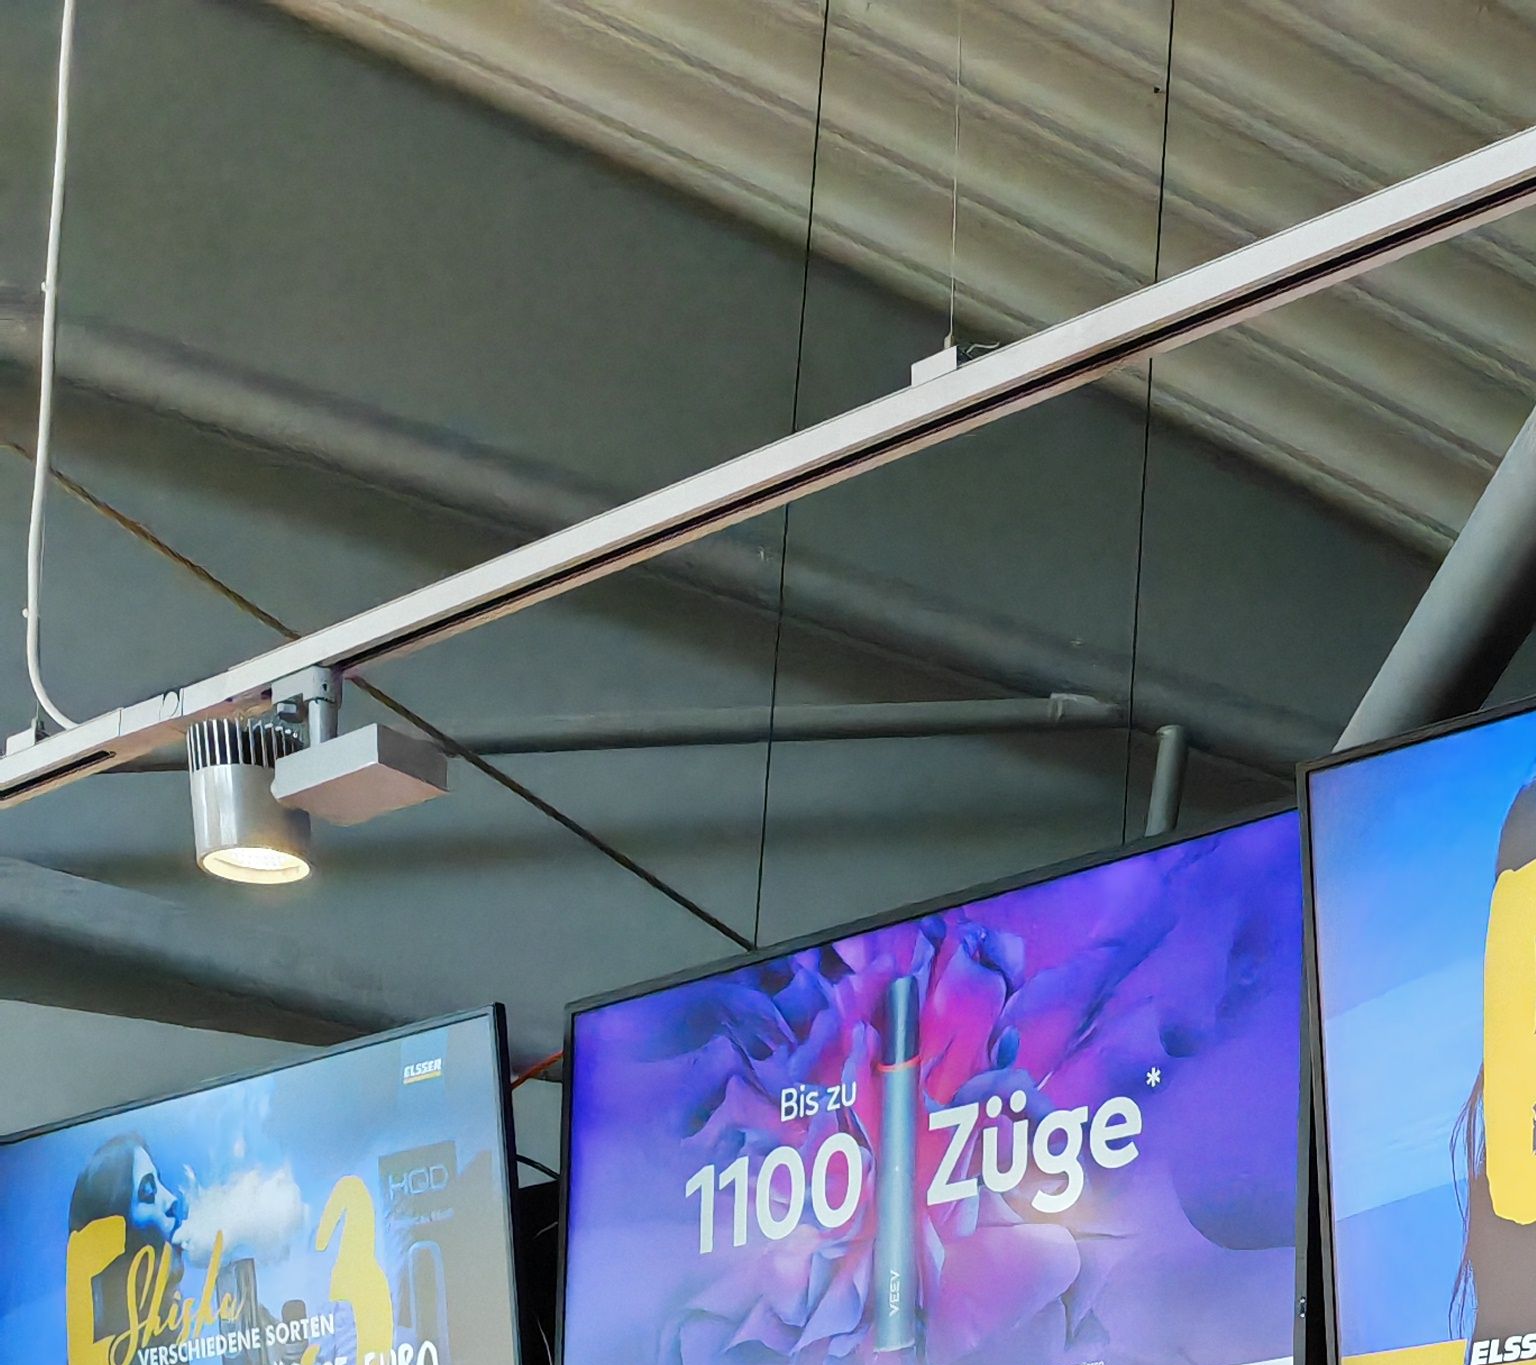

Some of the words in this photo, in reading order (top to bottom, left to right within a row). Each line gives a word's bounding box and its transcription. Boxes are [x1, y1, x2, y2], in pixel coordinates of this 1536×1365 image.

[403, 1059, 442, 1078] ELSSER
[780, 1084, 820, 1123] Bis
[826, 1083, 858, 1111] zu
[685, 1131, 863, 1254] 1100
[887, 1269, 902, 1317] VEEV
[265, 1313, 335, 1347] SORTEN
